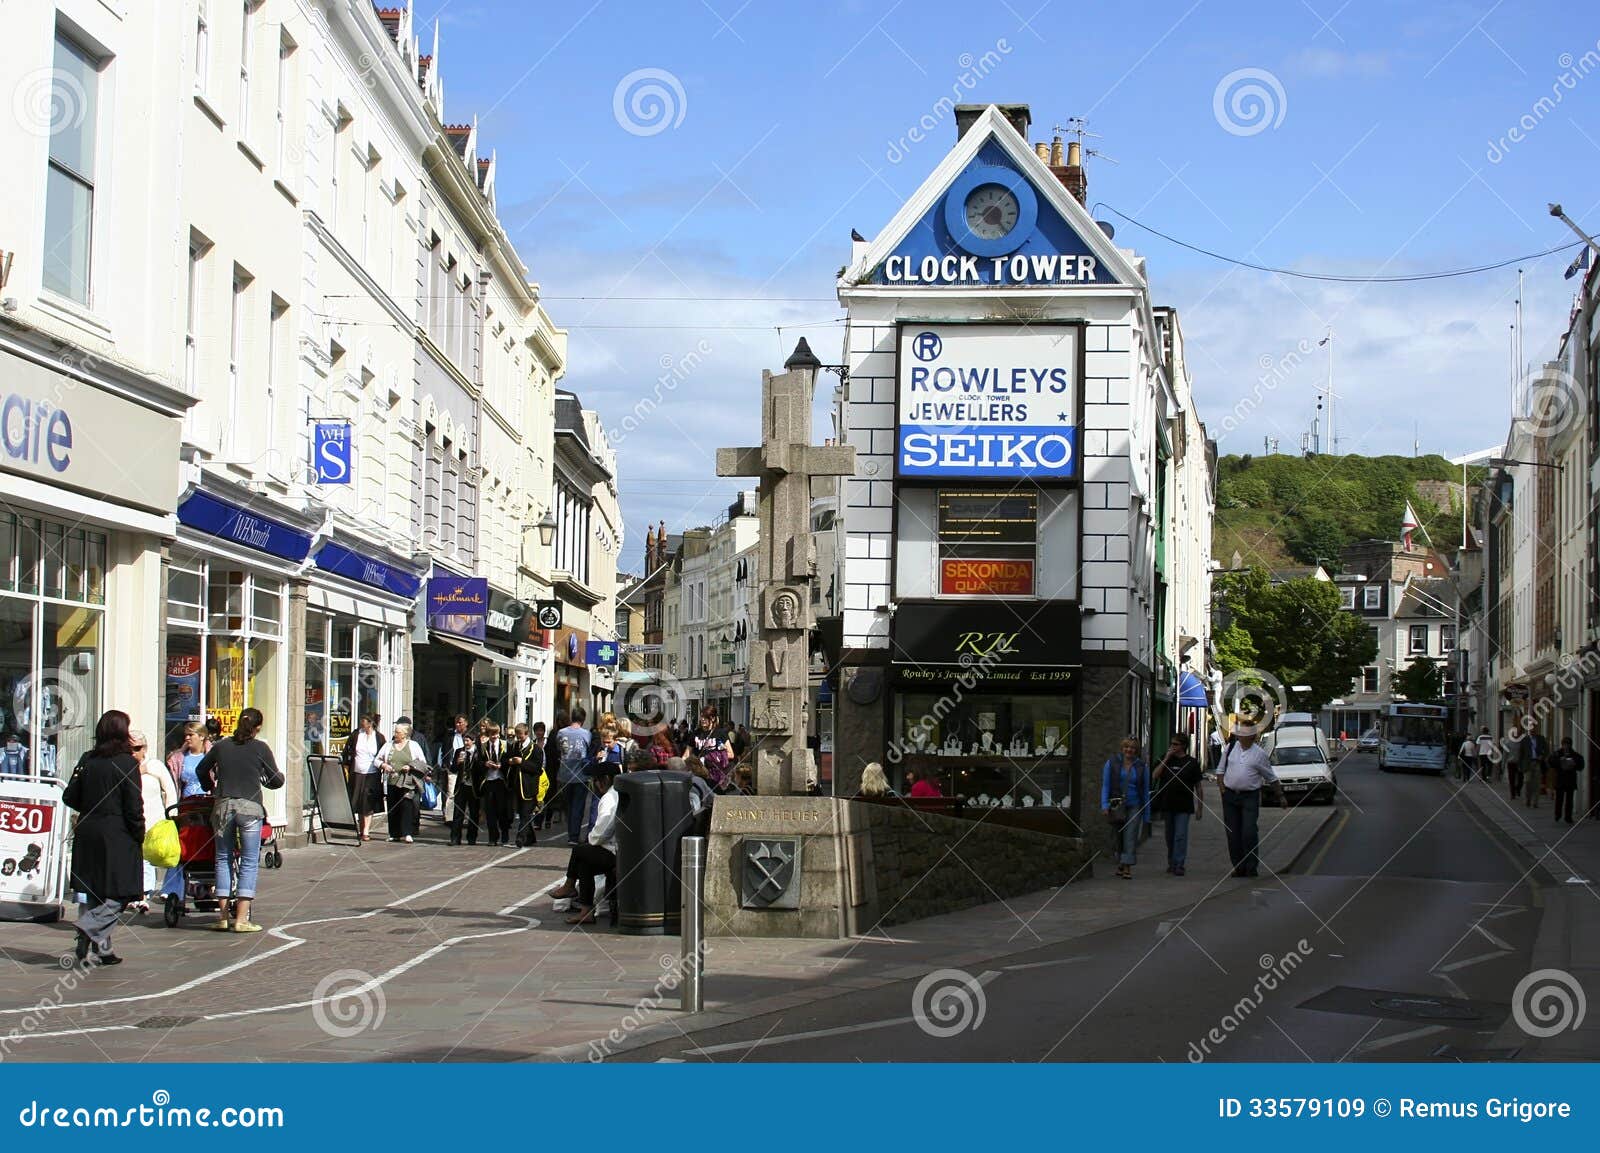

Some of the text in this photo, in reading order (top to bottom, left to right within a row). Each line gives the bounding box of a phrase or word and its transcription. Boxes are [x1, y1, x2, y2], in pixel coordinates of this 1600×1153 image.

[885, 254, 1097, 282] CLOCK TOWER
[911, 367, 1067, 394] ROWLEYS
[909, 403, 1027, 421] JEWELLERS
[0, 393, 73, 472] are
[320, 428, 345, 440] WH
[903, 433, 1072, 469] SEIKO
[320, 440, 346, 480] S
[231, 513, 271, 548] WHSmith
[945, 563, 1030, 578] SEKONDA
[955, 581, 1020, 593] QUARTZ
[433, 591, 484, 605] Hallmark
[167, 656, 193, 668] HALF
[986, 671, 1021, 680] Limited
[1030, 671, 1046, 680] Est
[1049, 672, 1071, 681] 1959
[330, 715, 350, 727] EW
[0, 806, 43, 833] £30
[726, 808, 819, 822] SAINT HELIER
